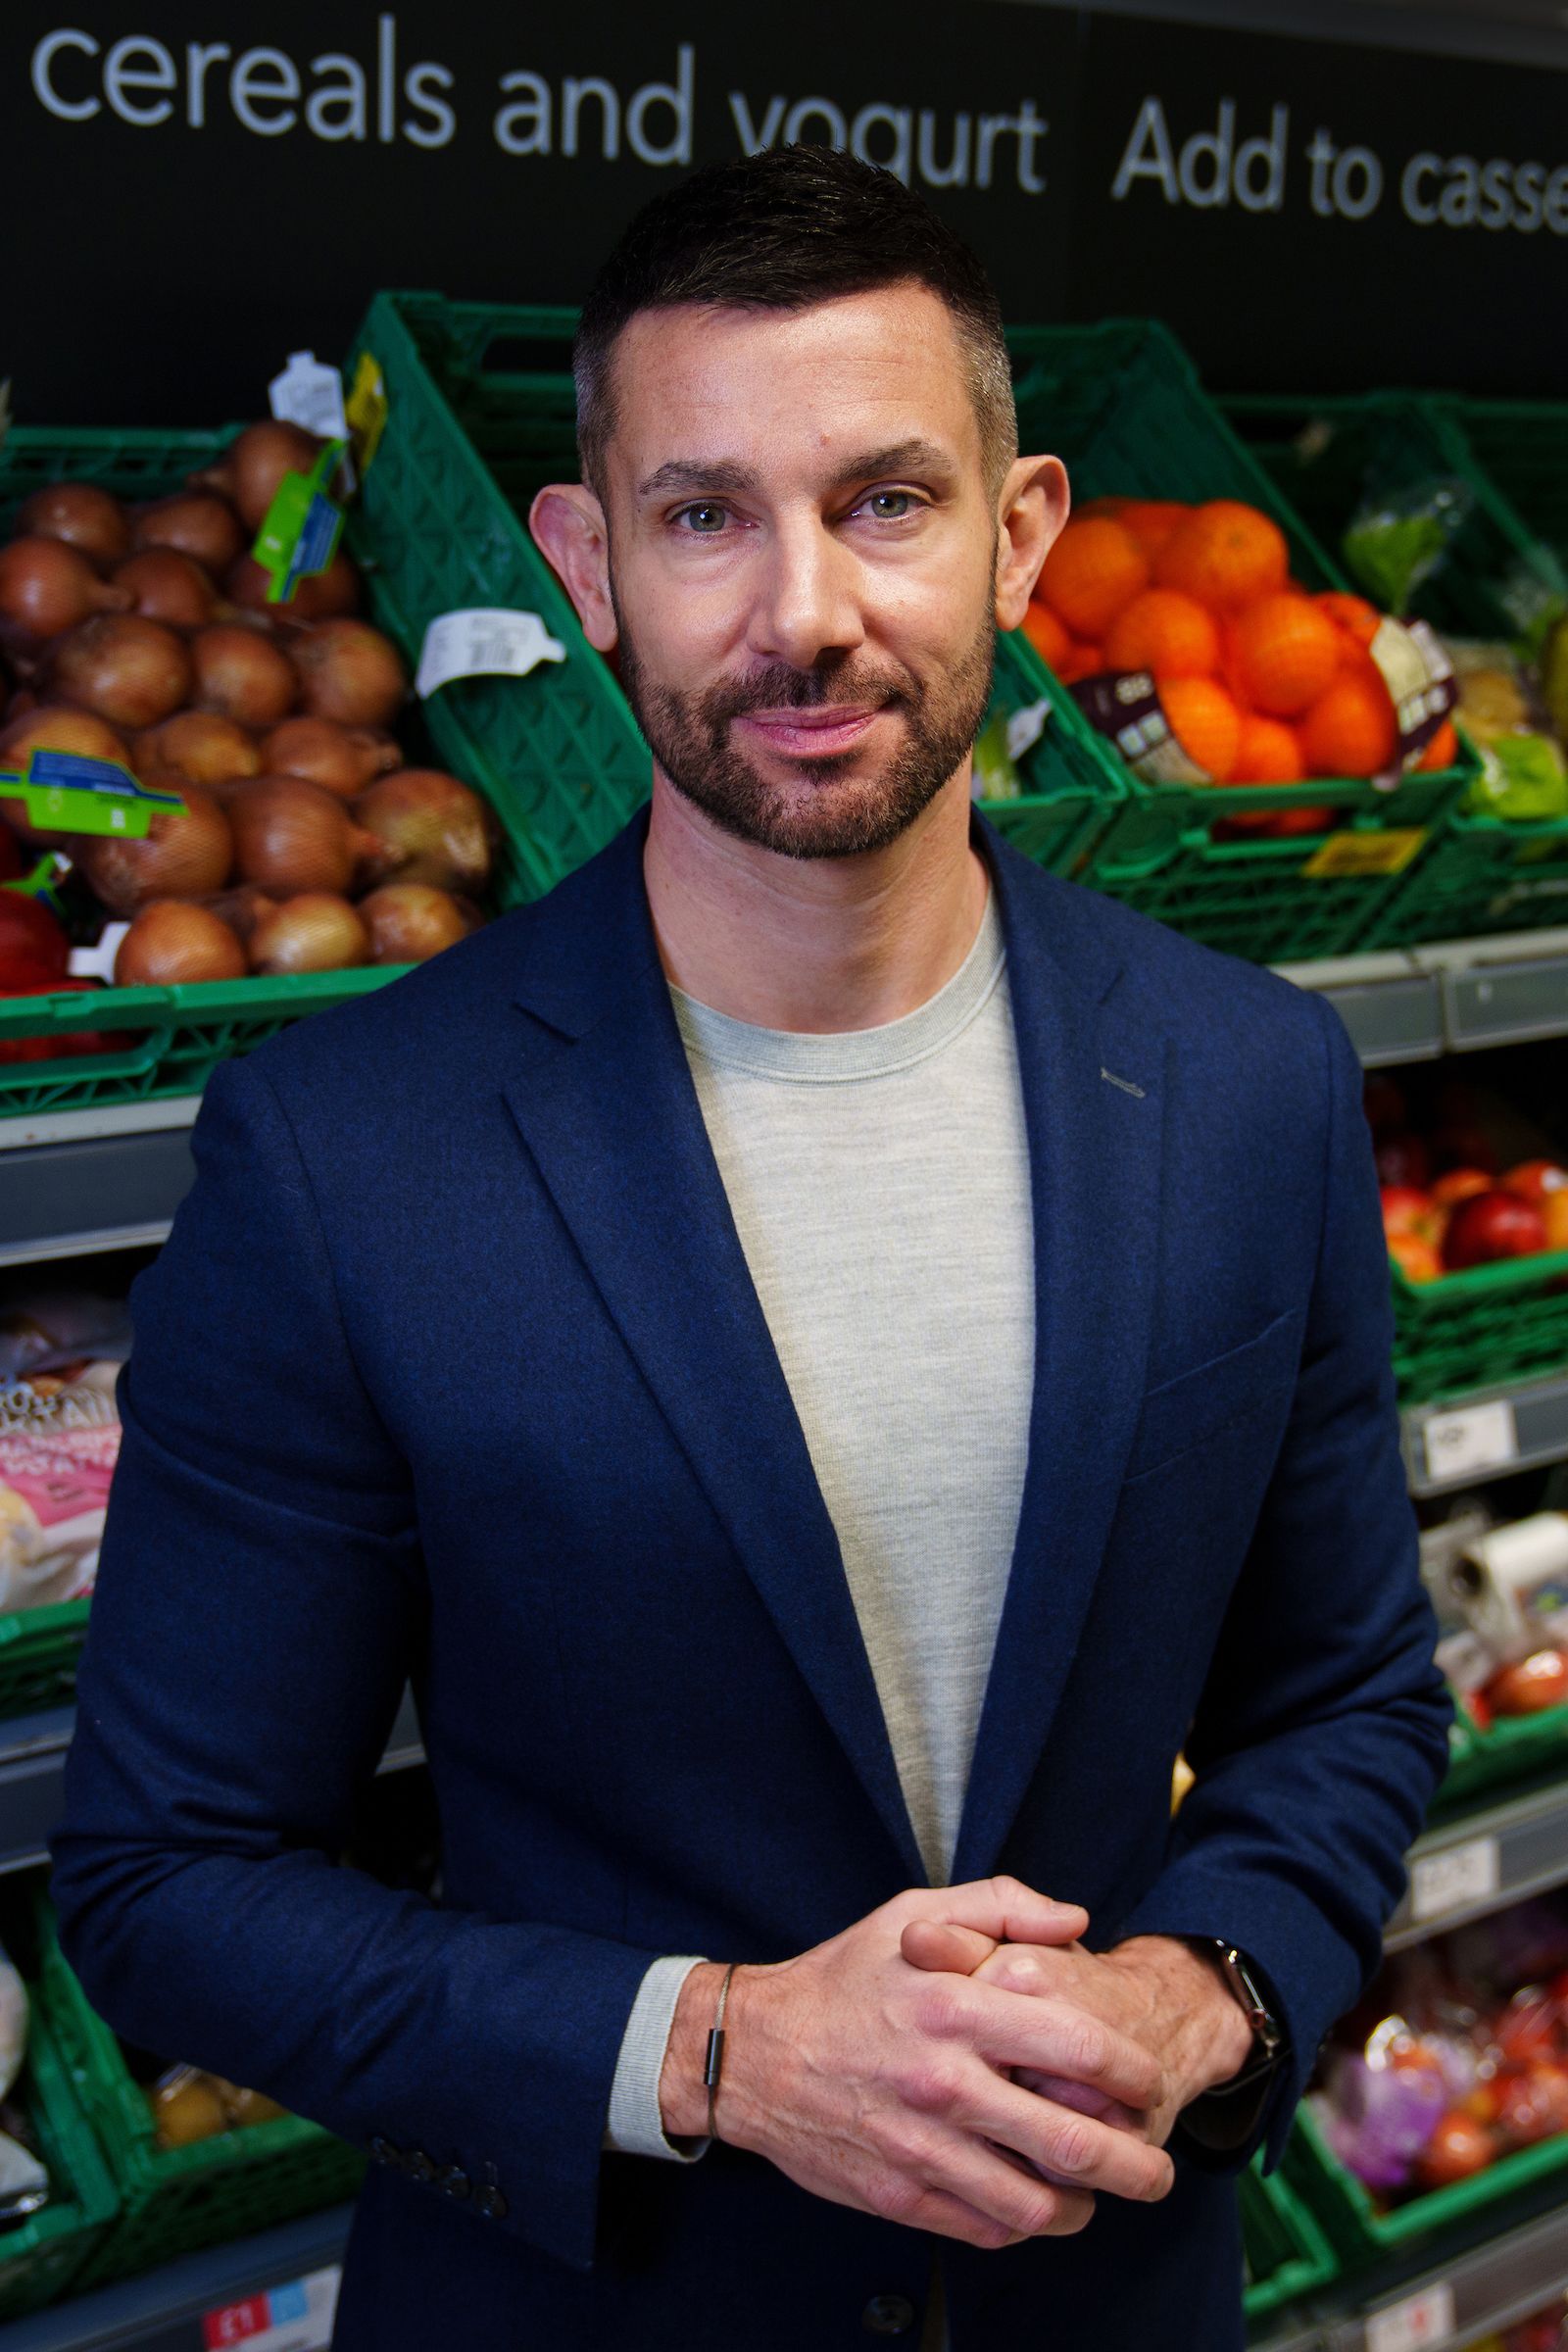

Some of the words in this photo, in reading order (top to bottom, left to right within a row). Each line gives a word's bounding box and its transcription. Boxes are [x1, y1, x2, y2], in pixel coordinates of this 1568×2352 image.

[30, 13, 457, 149] cereals
[493, 44, 695, 166] and
[729, 92, 1048, 194] yogurt
[1111, 98, 1289, 212] Add
[1306, 126, 1383, 219] to
[1401, 153, 1568, 233] casse
